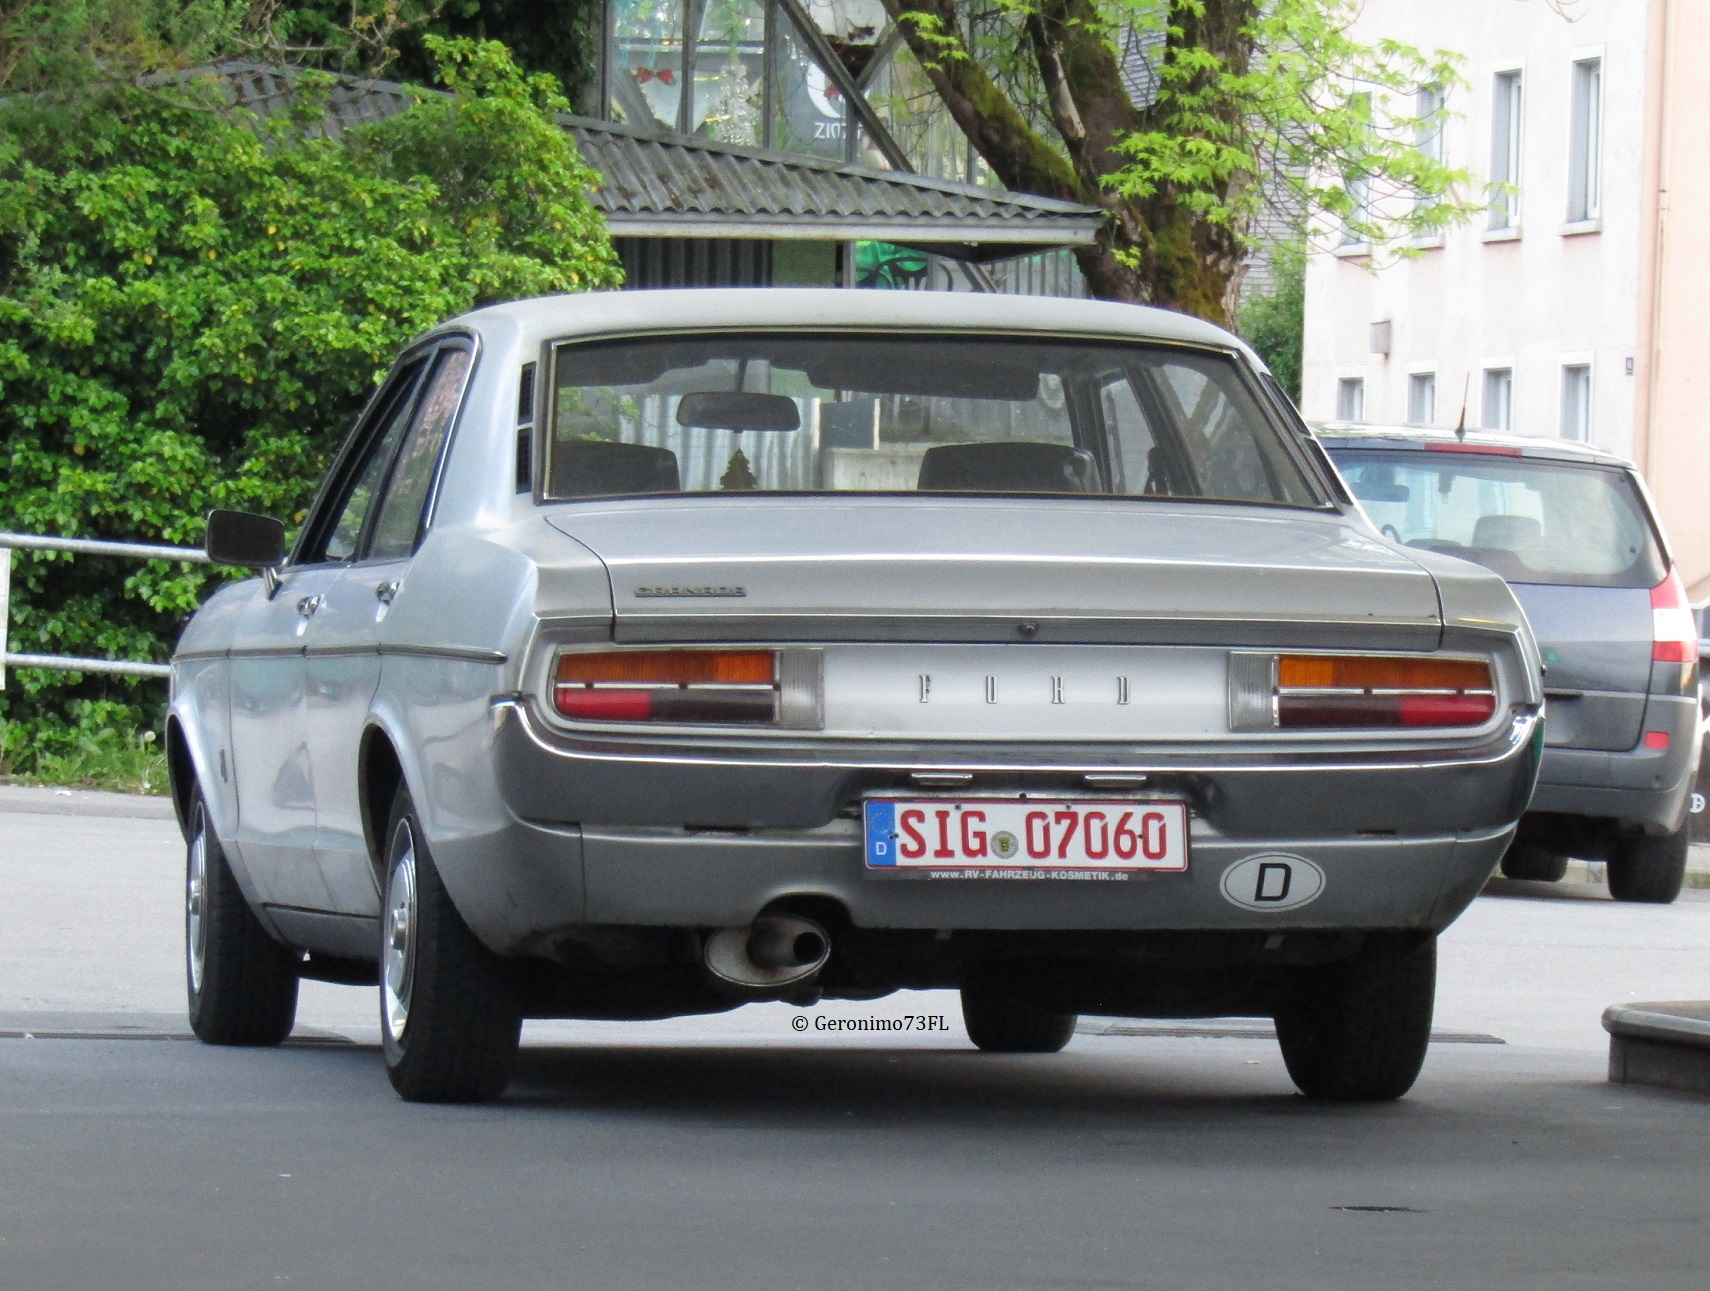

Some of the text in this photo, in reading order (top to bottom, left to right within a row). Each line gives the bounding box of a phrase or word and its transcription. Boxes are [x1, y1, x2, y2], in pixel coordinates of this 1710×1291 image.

[919, 674, 1130, 705] FORD
[875, 841, 887, 856] D
[900, 810, 1167, 860] SIG 07060
[929, 870, 1129, 881] www.RV-FAHRZEUG-KOSMETIK.de
[1254, 862, 1292, 902] D
